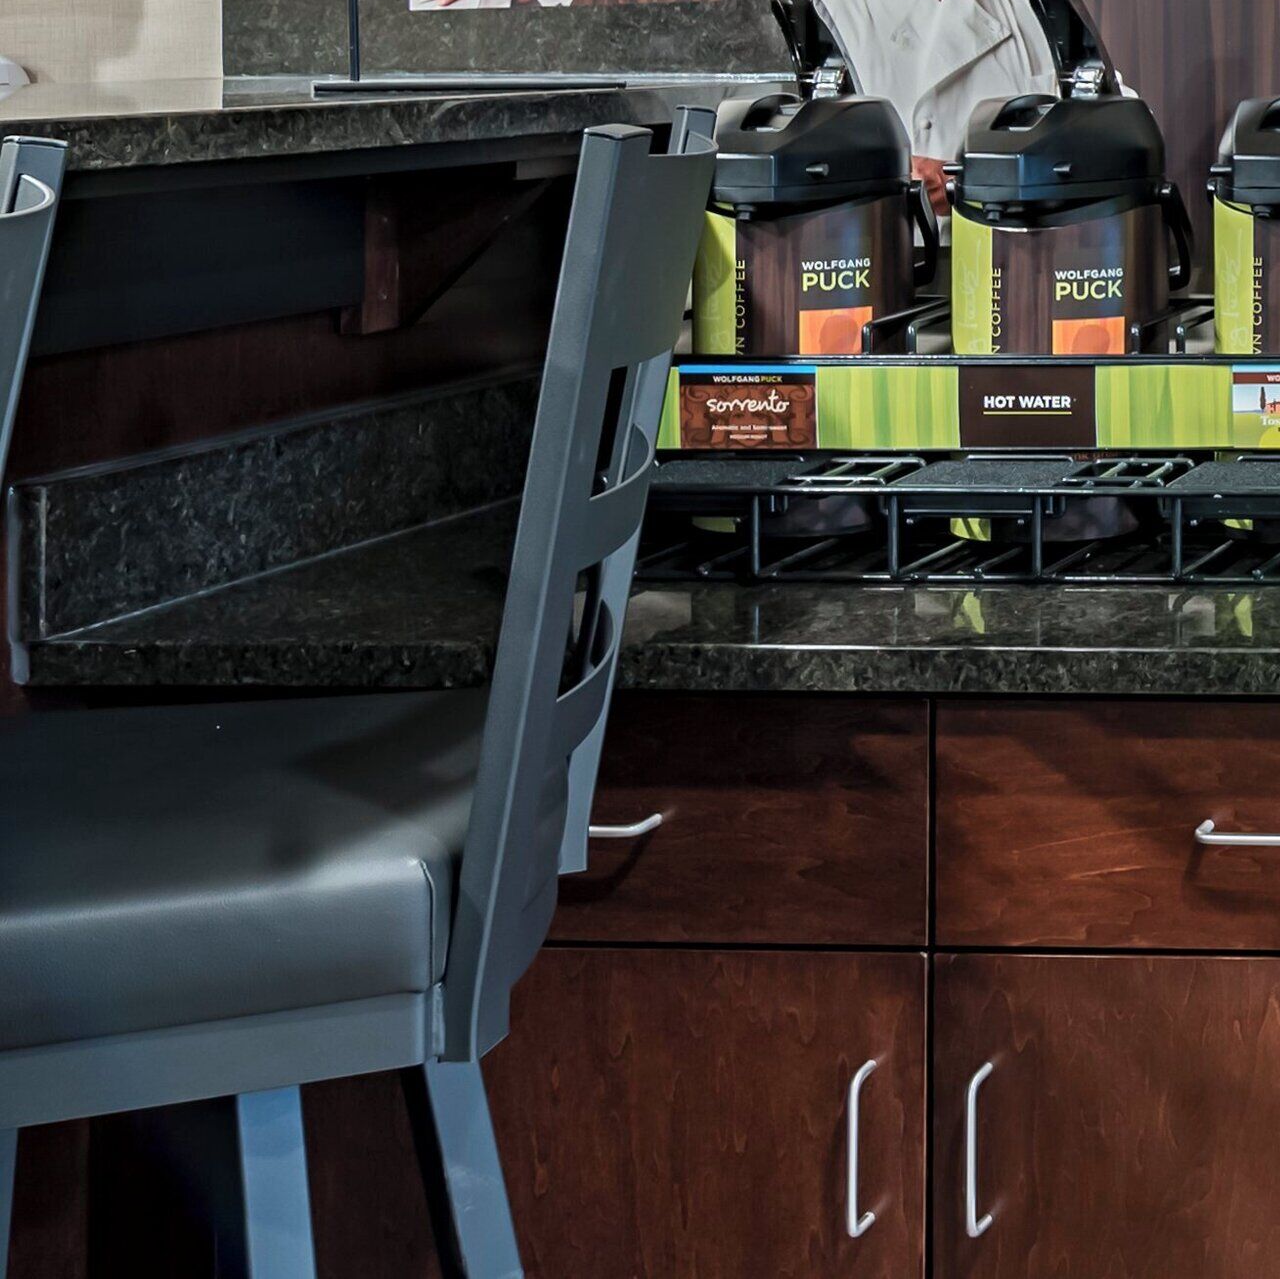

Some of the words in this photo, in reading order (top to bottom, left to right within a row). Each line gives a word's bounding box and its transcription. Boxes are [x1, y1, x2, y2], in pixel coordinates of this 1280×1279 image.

[802, 258, 871, 270] WOLFGANG
[1055, 268, 1123, 280] WOLFGANG
[802, 269, 870, 292] PUCK
[1055, 279, 1122, 301] PUCK
[1253, 257, 1263, 326] COFFEE
[736, 259, 746, 329] COFFEE
[991, 268, 1001, 337] COFFEE
[706, 388, 790, 412] sorrento
[983, 396, 1015, 409] HOT
[1019, 396, 1071, 408] WATER
